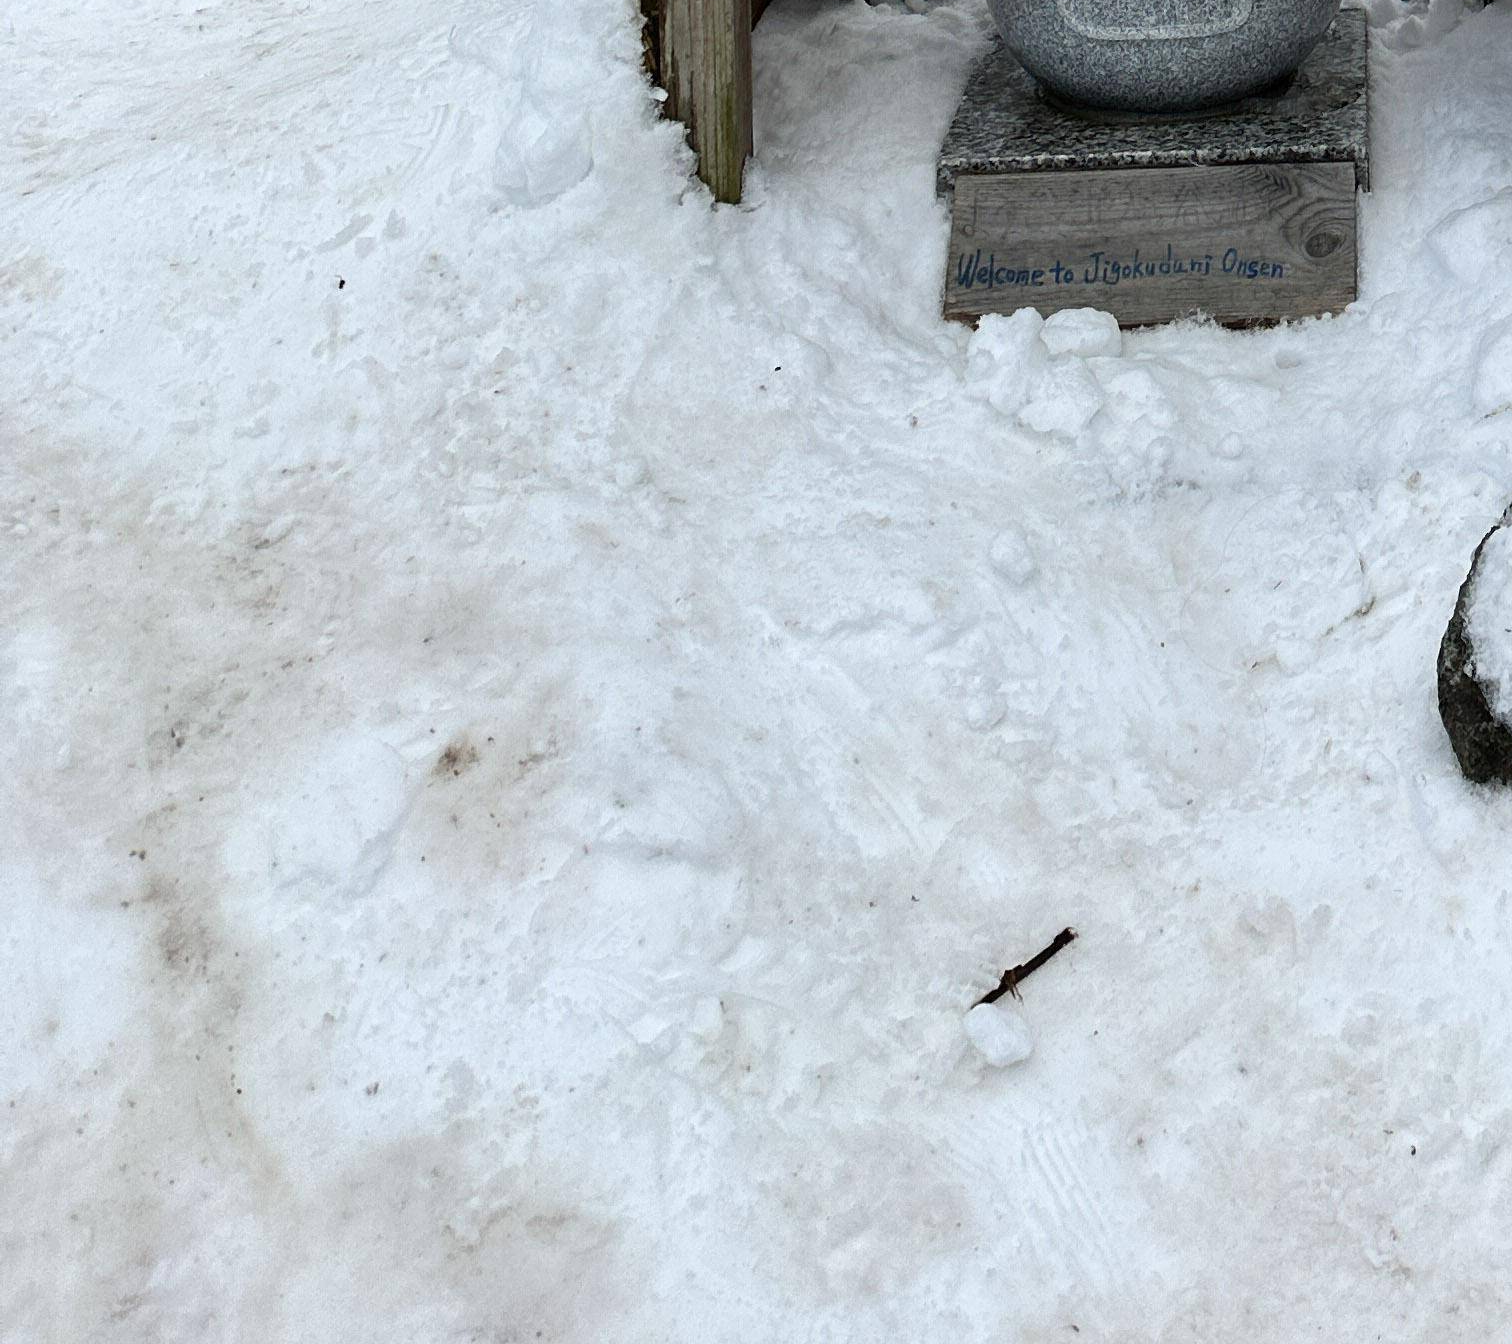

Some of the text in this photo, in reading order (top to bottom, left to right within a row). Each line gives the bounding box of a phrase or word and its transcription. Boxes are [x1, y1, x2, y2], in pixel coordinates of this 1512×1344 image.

[957, 248, 1045, 289] Welcome
[1053, 260, 1074, 285] to
[1222, 248, 1285, 279] Onsen
